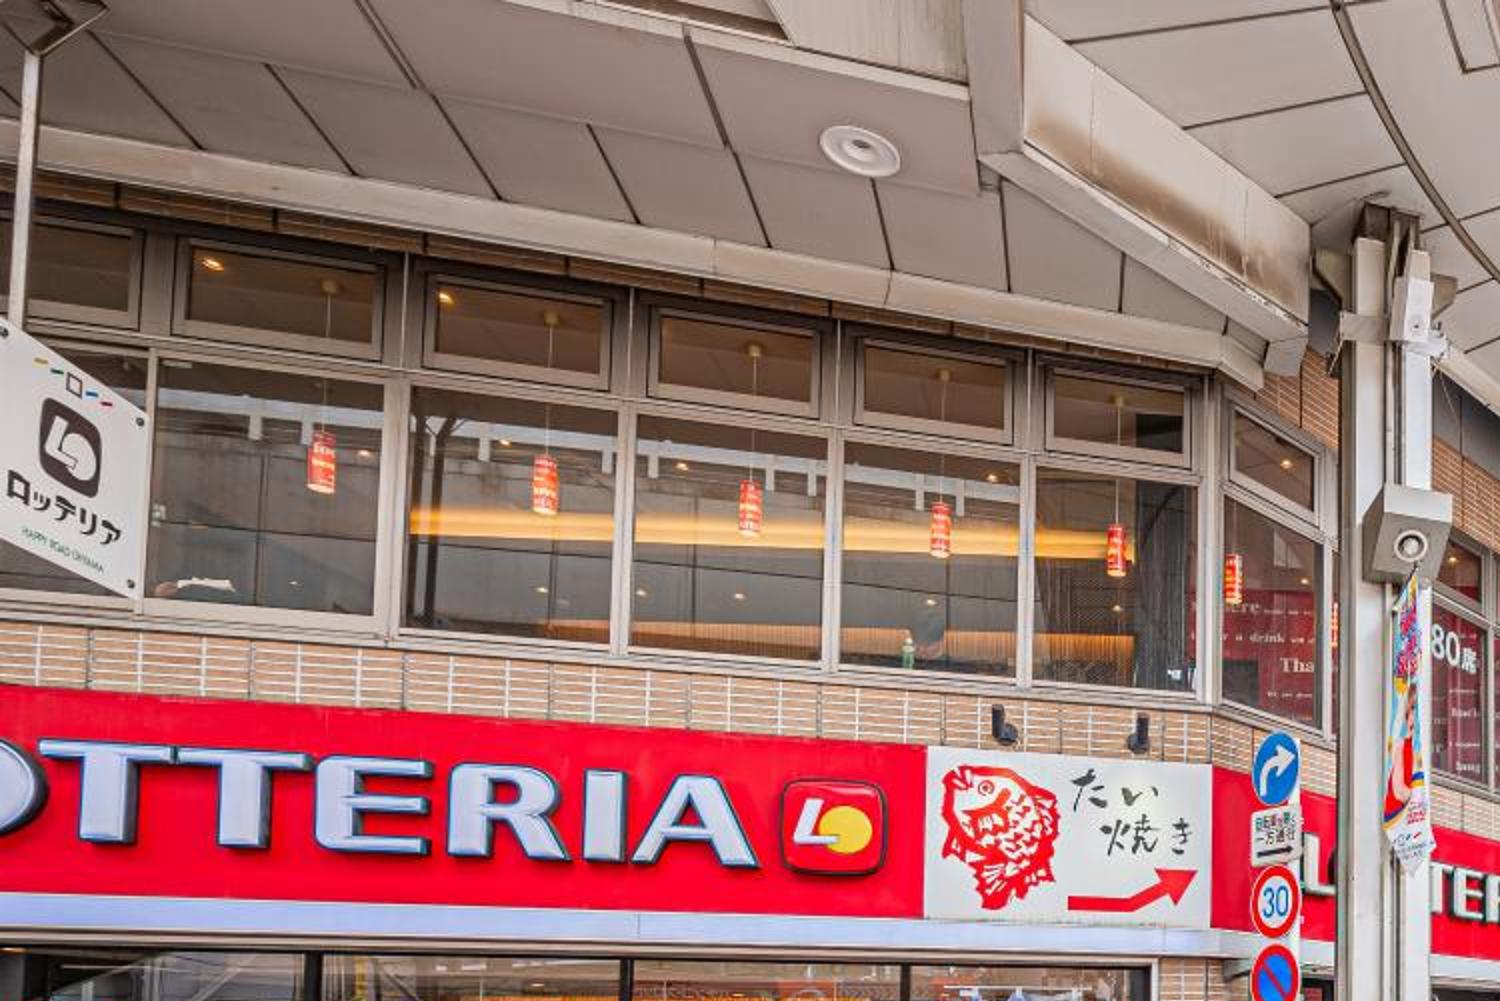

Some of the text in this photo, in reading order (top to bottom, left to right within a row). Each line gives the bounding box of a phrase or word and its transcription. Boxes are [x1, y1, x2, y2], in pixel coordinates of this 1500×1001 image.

[7, 469, 121, 545] ロッテリア
[1070, 768, 1159, 812] たい
[1099, 813, 1193, 857] 焼き
[1262, 884, 1289, 918] 30
